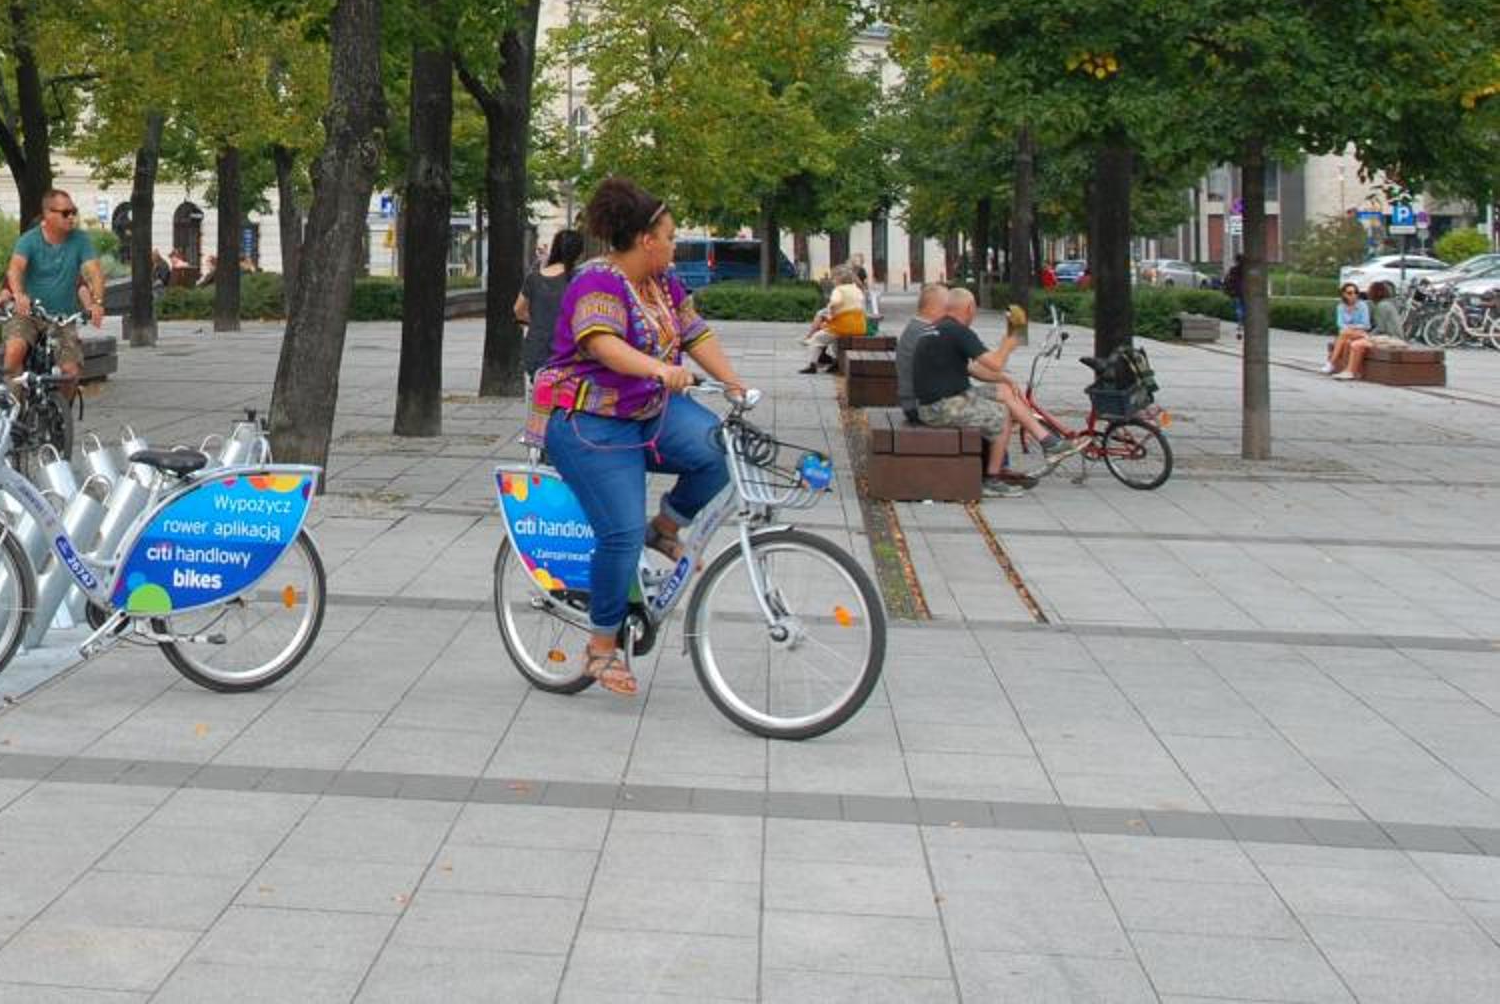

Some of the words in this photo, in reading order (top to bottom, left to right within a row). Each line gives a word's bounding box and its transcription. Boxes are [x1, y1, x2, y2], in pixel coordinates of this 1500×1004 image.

[1397, 205, 1410, 223] P
[213, 493, 292, 515] Wypożycz
[163, 519, 207, 534] rower
[213, 520, 282, 542] aplikacją
[515, 516, 537, 535] citi
[538, 517, 595, 538] handlow
[146, 544, 173, 561] citi
[175, 545, 251, 569] handlowy
[173, 567, 223, 589] bikes
